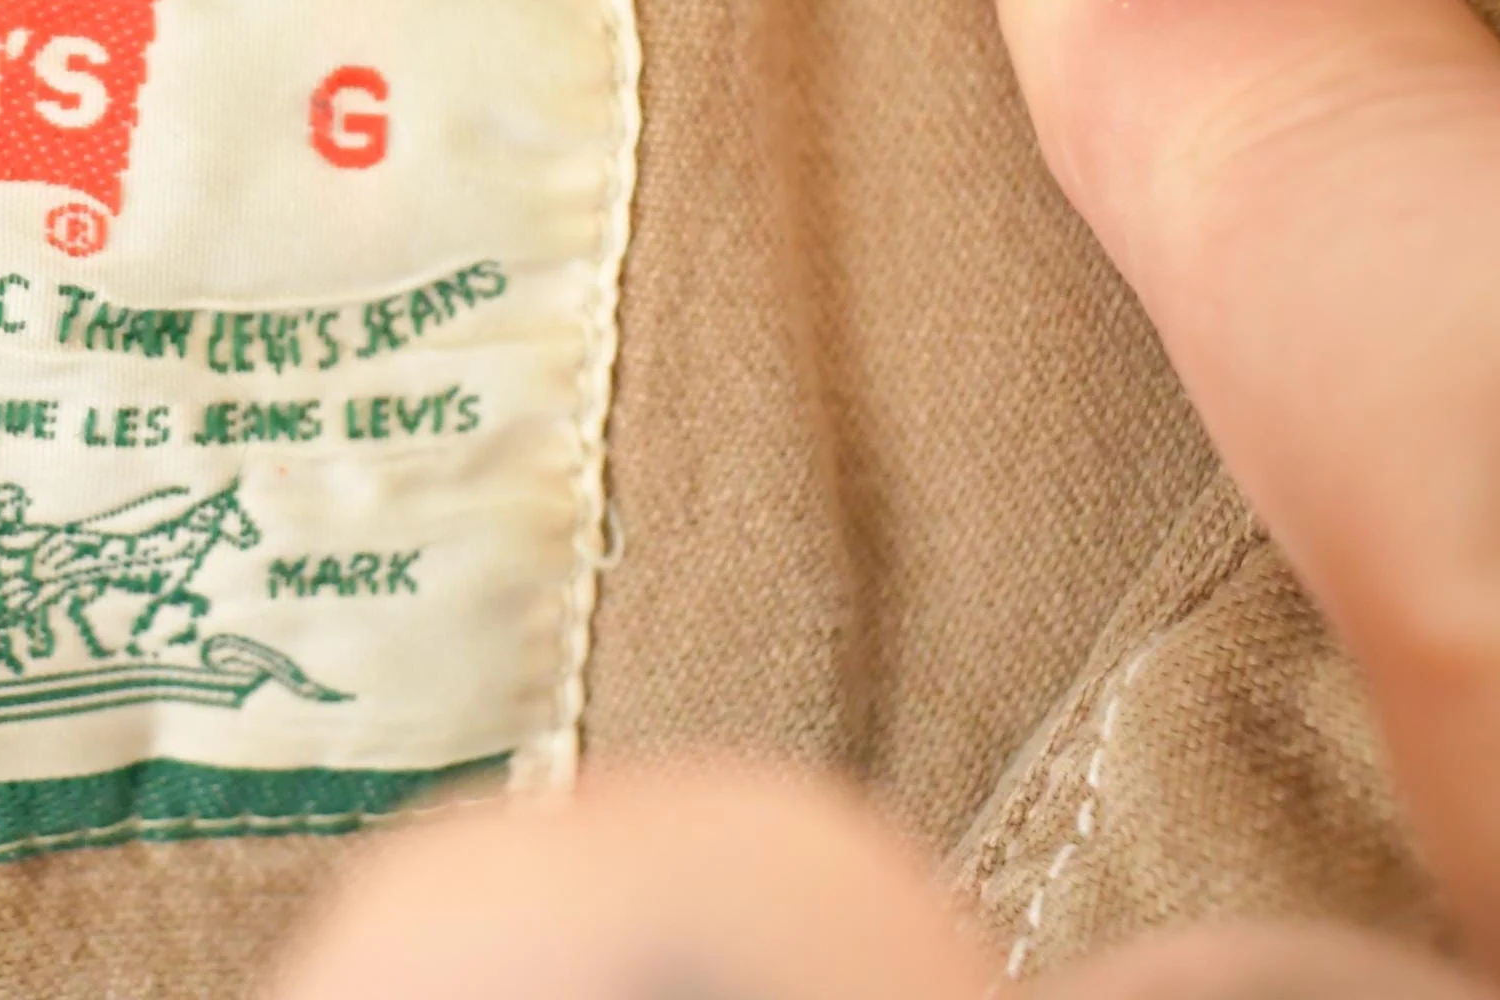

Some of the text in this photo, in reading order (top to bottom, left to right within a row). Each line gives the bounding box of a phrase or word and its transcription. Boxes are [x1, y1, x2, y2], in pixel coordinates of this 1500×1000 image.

[309, 65, 389, 168] G
[57, 284, 194, 358] THAN
[206, 307, 340, 374] LEVI'S
[356, 258, 509, 358] JEANS
[83, 405, 170, 447] LES
[193, 400, 323, 446] JEANS
[345, 386, 480, 440] LEVI'S
[266, 549, 424, 601] MARK
